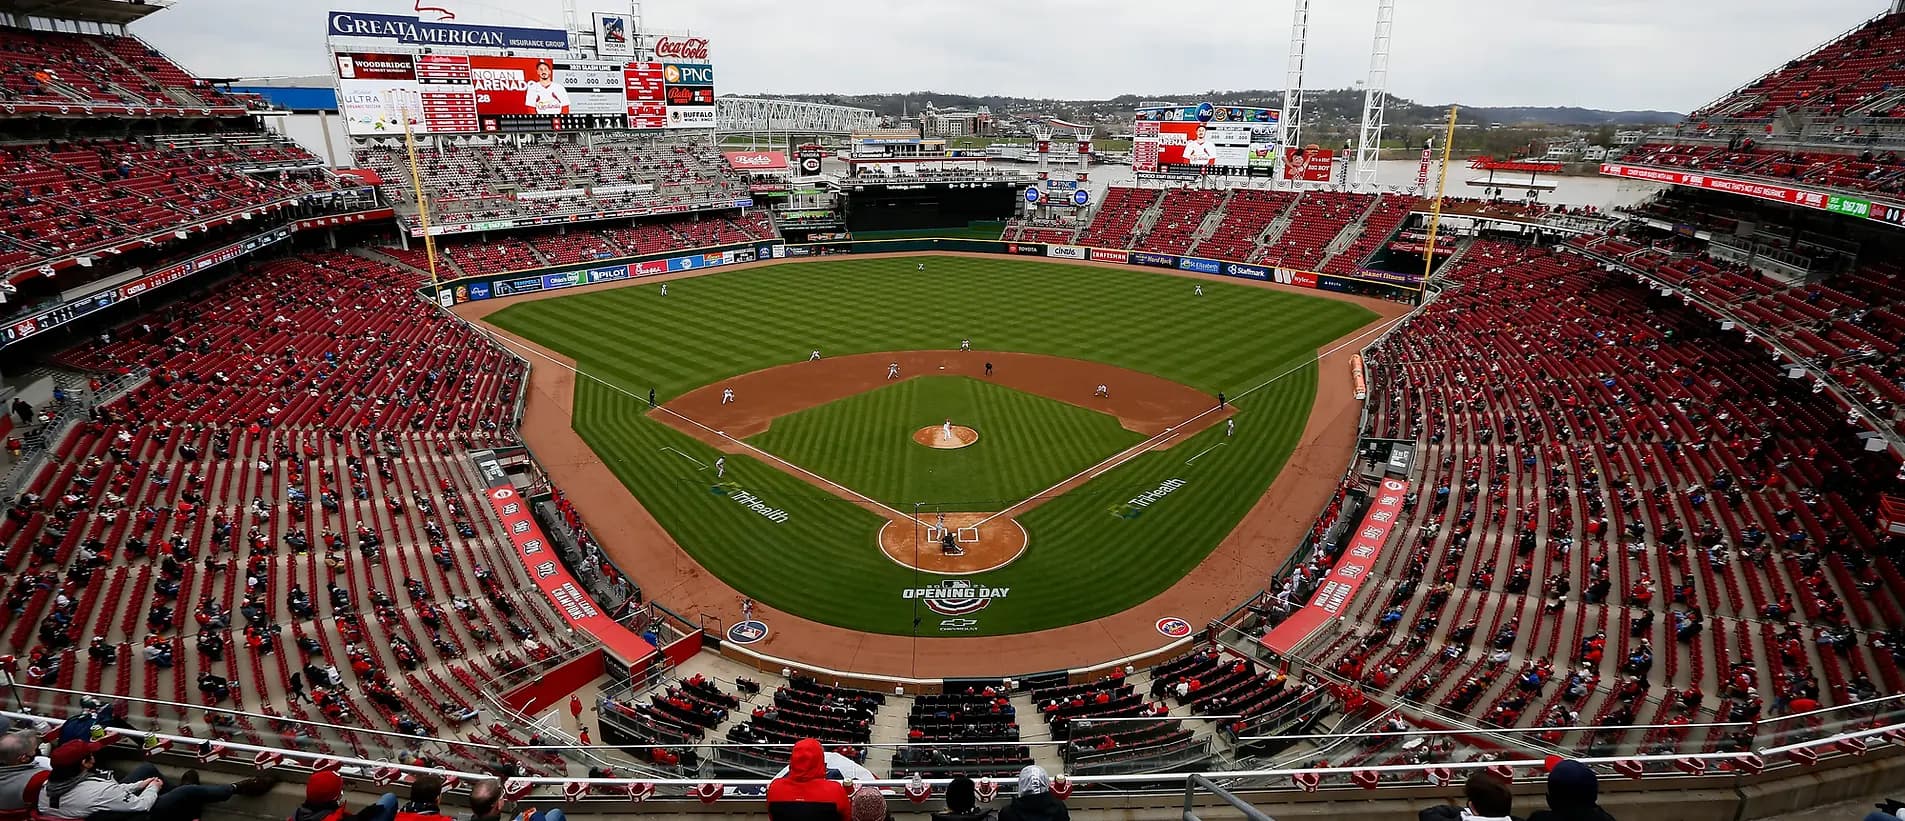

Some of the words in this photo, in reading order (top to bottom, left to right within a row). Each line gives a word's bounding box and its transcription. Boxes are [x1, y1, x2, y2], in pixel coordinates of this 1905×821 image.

[333, 14, 407, 36] GREAT
[509, 39, 544, 47] INSURANCE
[655, 37, 710, 59] Coca-Cola
[354, 60, 412, 69] WOODBRIDGE
[473, 71, 516, 80] NOLAN
[682, 68, 712, 84] PNC
[345, 95, 381, 103] ULTRA
[477, 94, 492, 103] 28
[668, 88, 693, 101] Bally
[683, 112, 713, 120] BUFFALO
[1198, 108, 1213, 118] P&G
[604, 118, 612, 128] 2
[735, 155, 771, 165] Reds
[1092, 250, 1127, 261] CRAFTSMAN
[1147, 256, 1160, 264] Hard
[1160, 258, 1173, 266] Rock
[599, 269, 625, 279] PILOT
[1361, 269, 1382, 280] planet
[1383, 273, 1406, 281] fitness
[1128, 477, 1187, 508] TriHealth
[731, 490, 789, 524] TriHealth
[902, 588, 975, 599] OPENING
[978, 587, 1010, 598] DAY
[1324, 583, 1352, 614] CHAMPIONS
[551, 587, 585, 620] CHAMPIONS
[578, 599, 598, 618] LEAGUE
